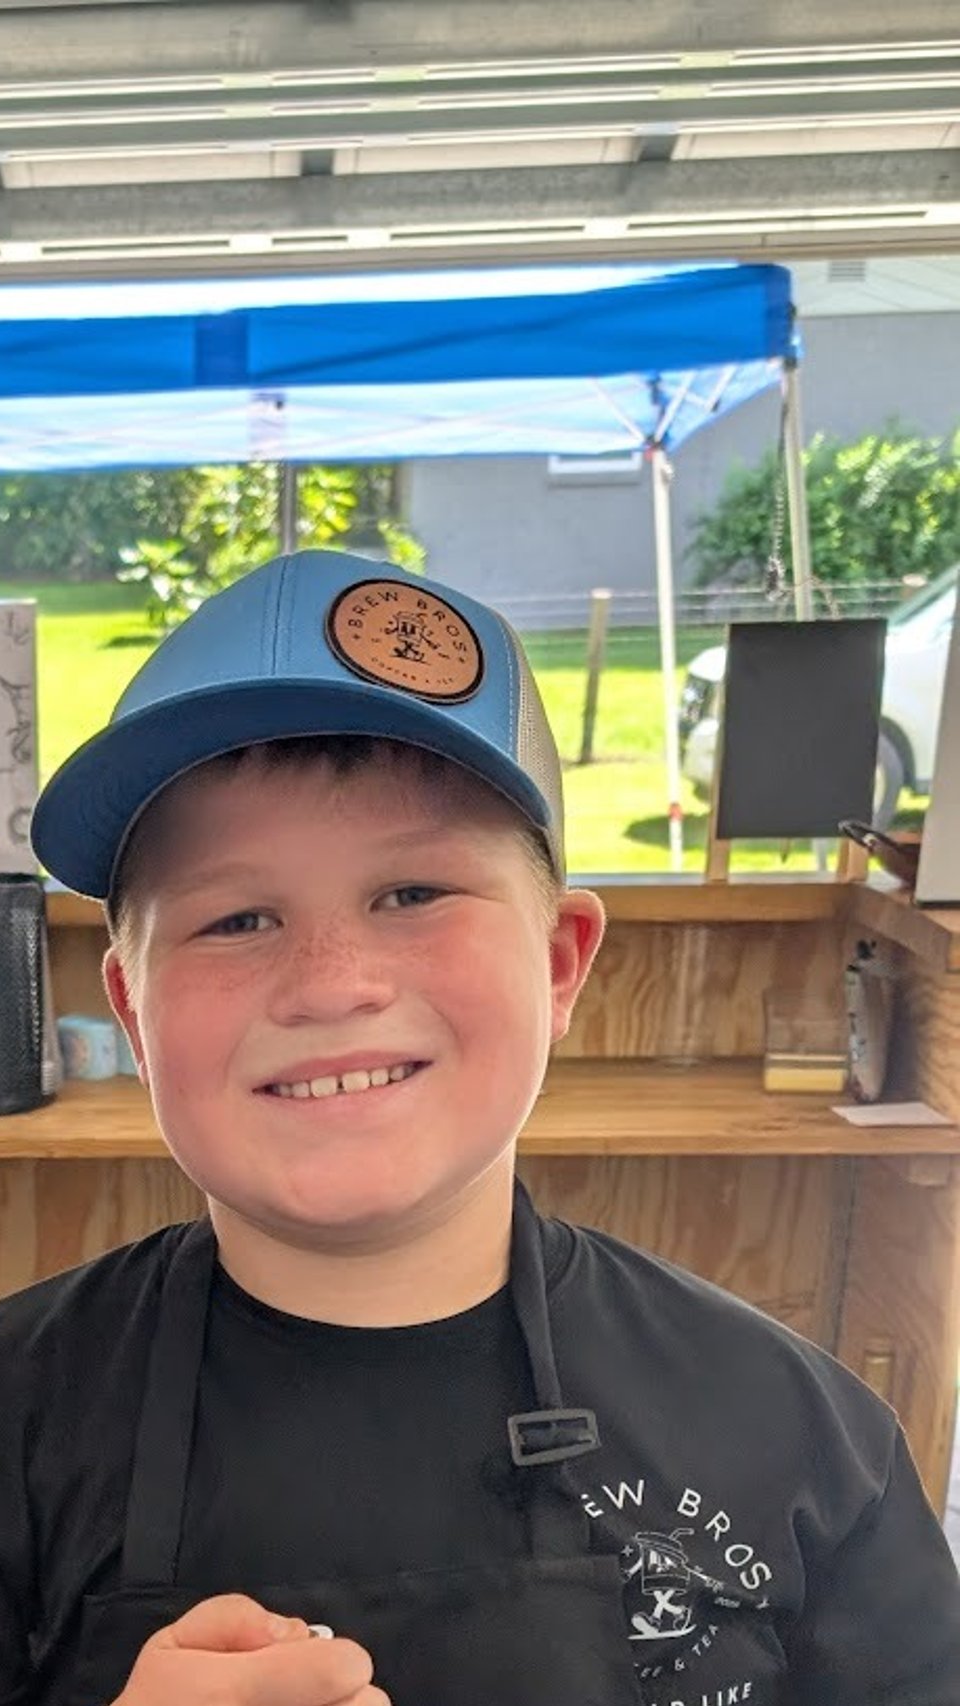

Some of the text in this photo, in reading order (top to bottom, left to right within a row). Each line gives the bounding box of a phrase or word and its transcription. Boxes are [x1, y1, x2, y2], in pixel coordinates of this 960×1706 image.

[348, 591, 468, 653] BREW BROS
[580, 1479, 773, 1590] EW BROS
